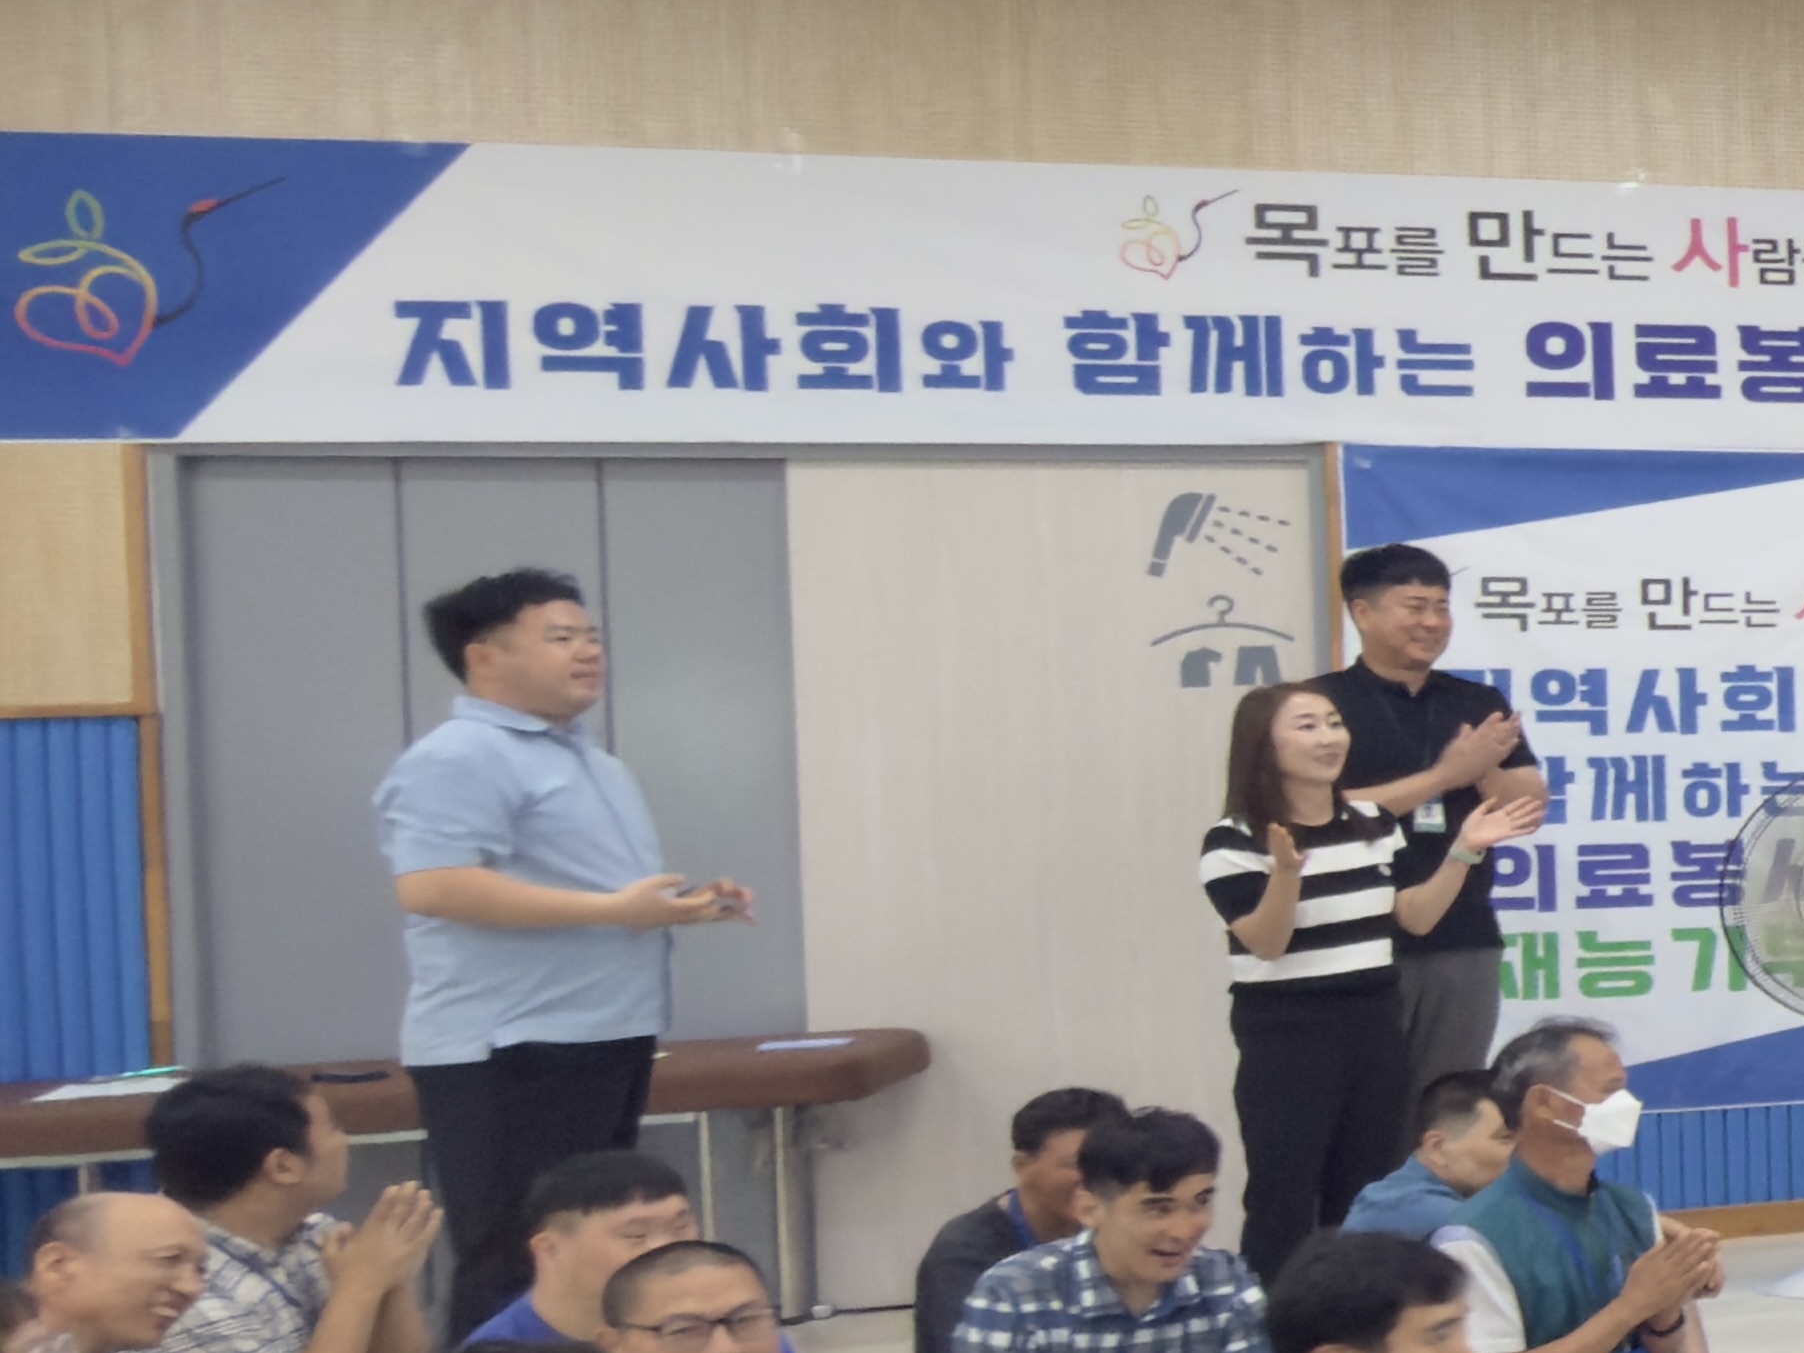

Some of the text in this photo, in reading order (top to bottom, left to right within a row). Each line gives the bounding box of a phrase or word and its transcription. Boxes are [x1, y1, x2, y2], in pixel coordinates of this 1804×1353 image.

[1245, 202, 1445, 279] 목포를
[1467, 208, 1654, 283] 만드는
[393, 299, 1014, 394] 지역사회와
[1062, 308, 1475, 399] 함께하는
[1474, 576, 1623, 633] 목포를
[1640, 576, 1780, 632] 만드는
